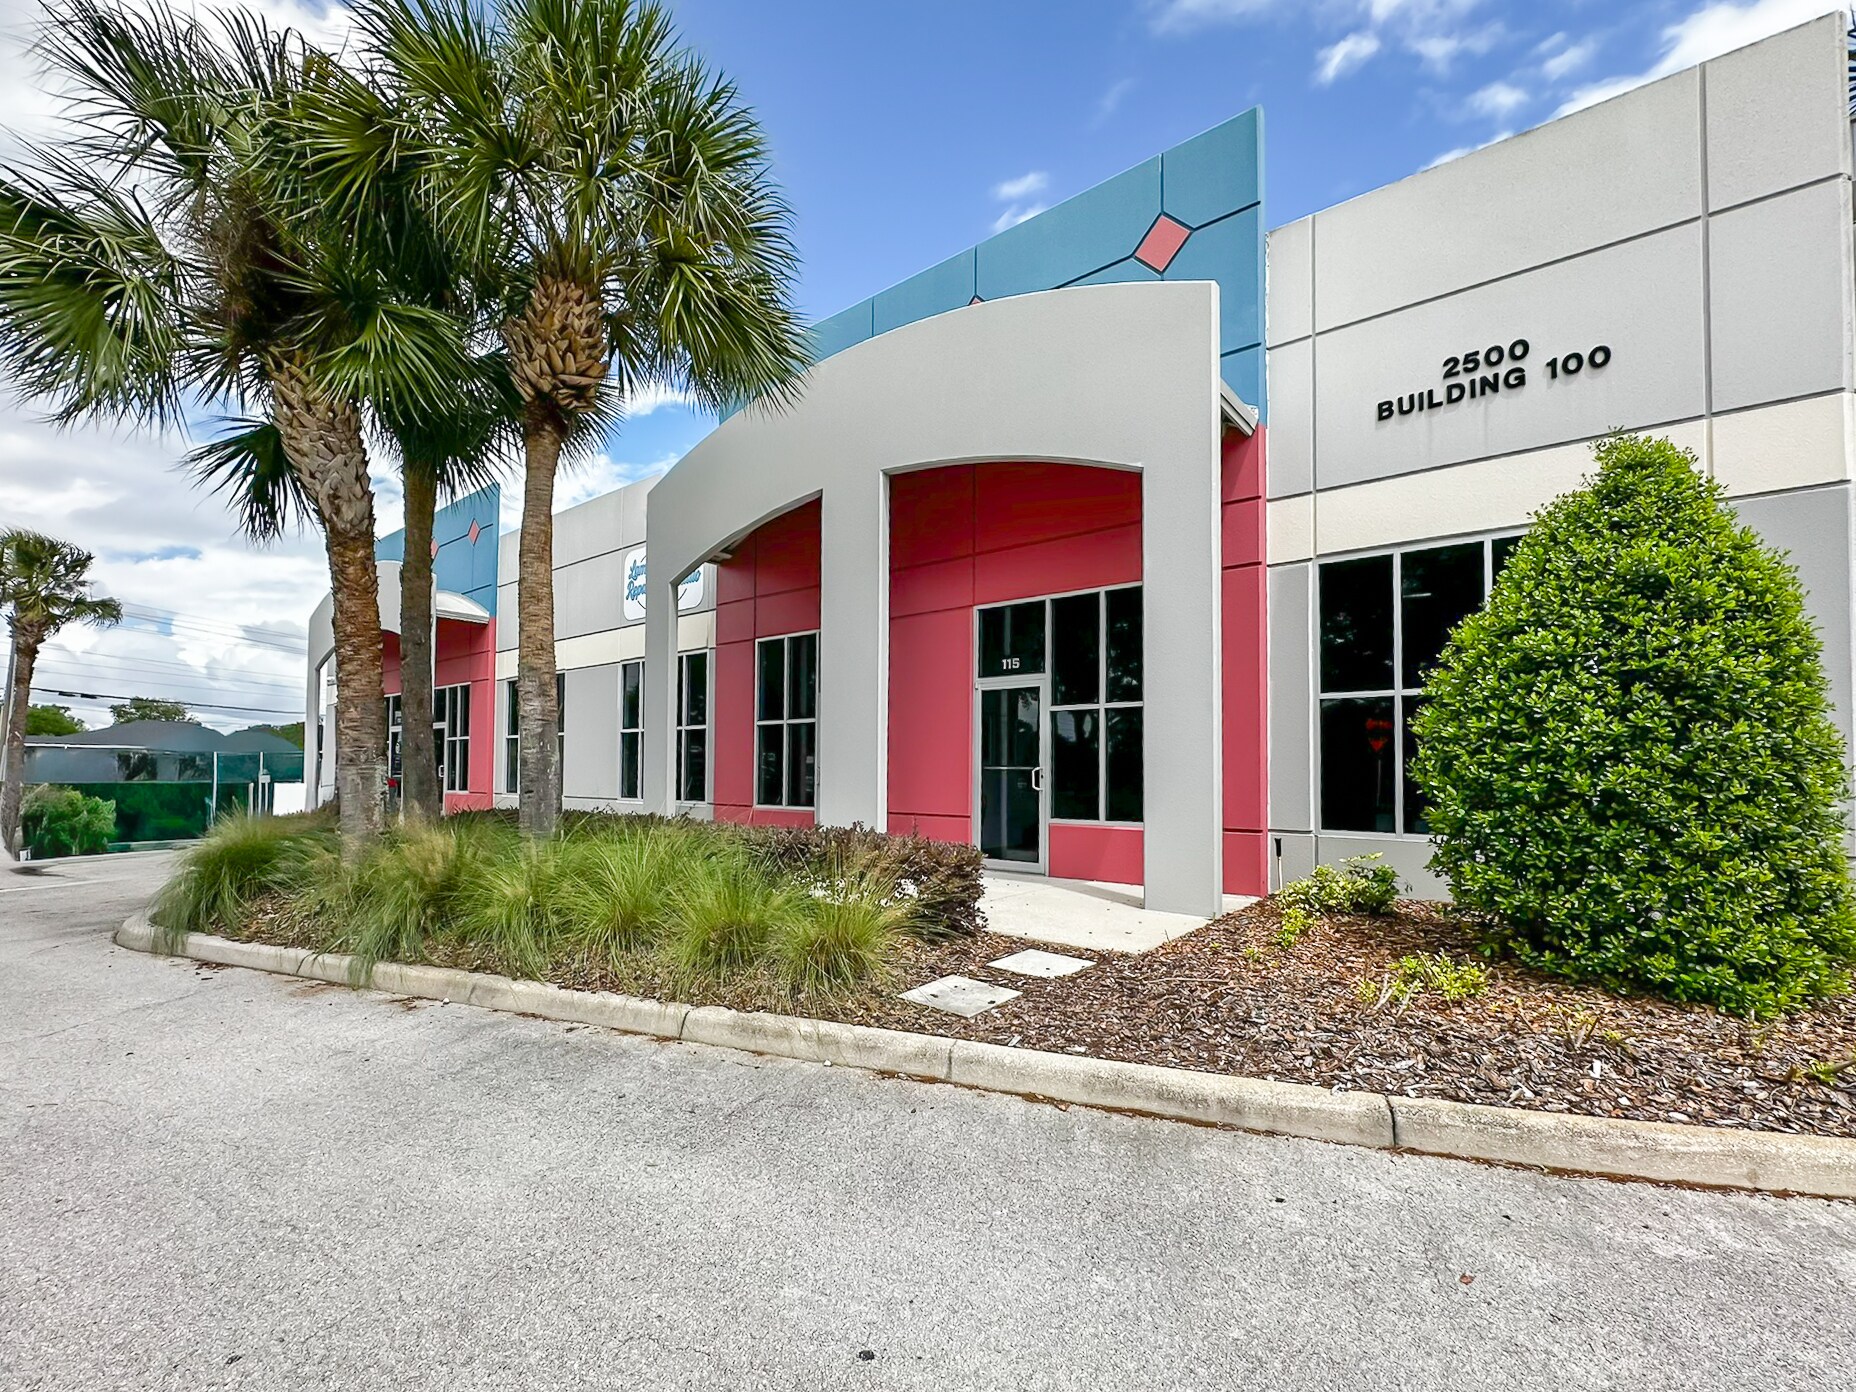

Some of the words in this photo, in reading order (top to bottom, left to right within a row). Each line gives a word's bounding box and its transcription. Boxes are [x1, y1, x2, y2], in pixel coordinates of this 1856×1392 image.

[1442, 338, 1530, 379] 2500
[1377, 366, 1526, 421] BUILDING
[1545, 345, 1612, 379] 100
[1002, 657, 1020, 670] 115
